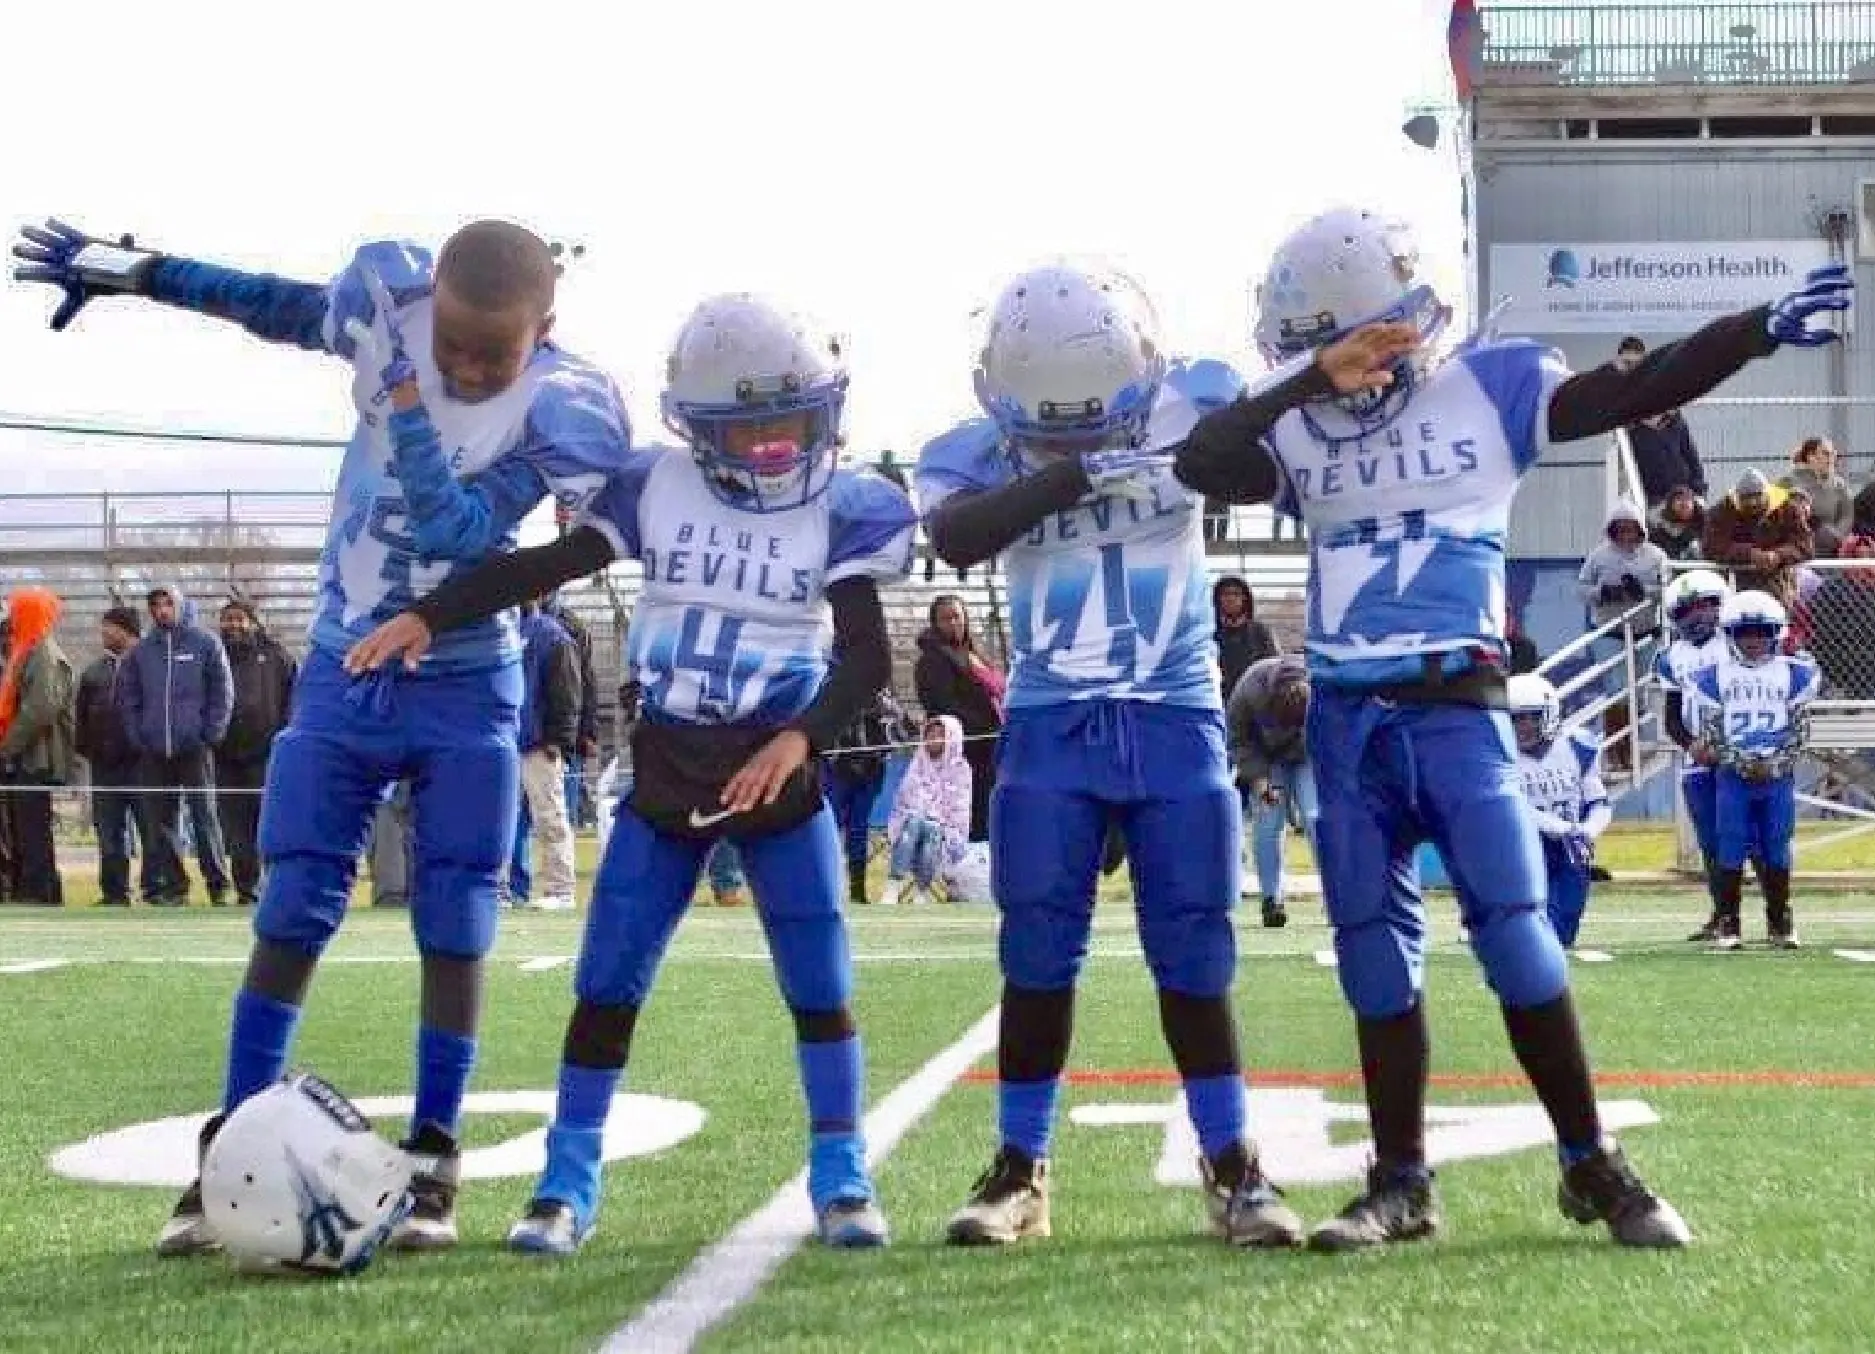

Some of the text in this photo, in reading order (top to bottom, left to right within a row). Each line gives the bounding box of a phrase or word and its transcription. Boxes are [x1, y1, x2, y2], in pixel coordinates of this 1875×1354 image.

[1586, 256, 1787, 279] Jefferson Health
[1027, 484, 1197, 547] DEVIL
[676, 522, 791, 559] BLUE
[644, 547, 810, 602] DEVILS
